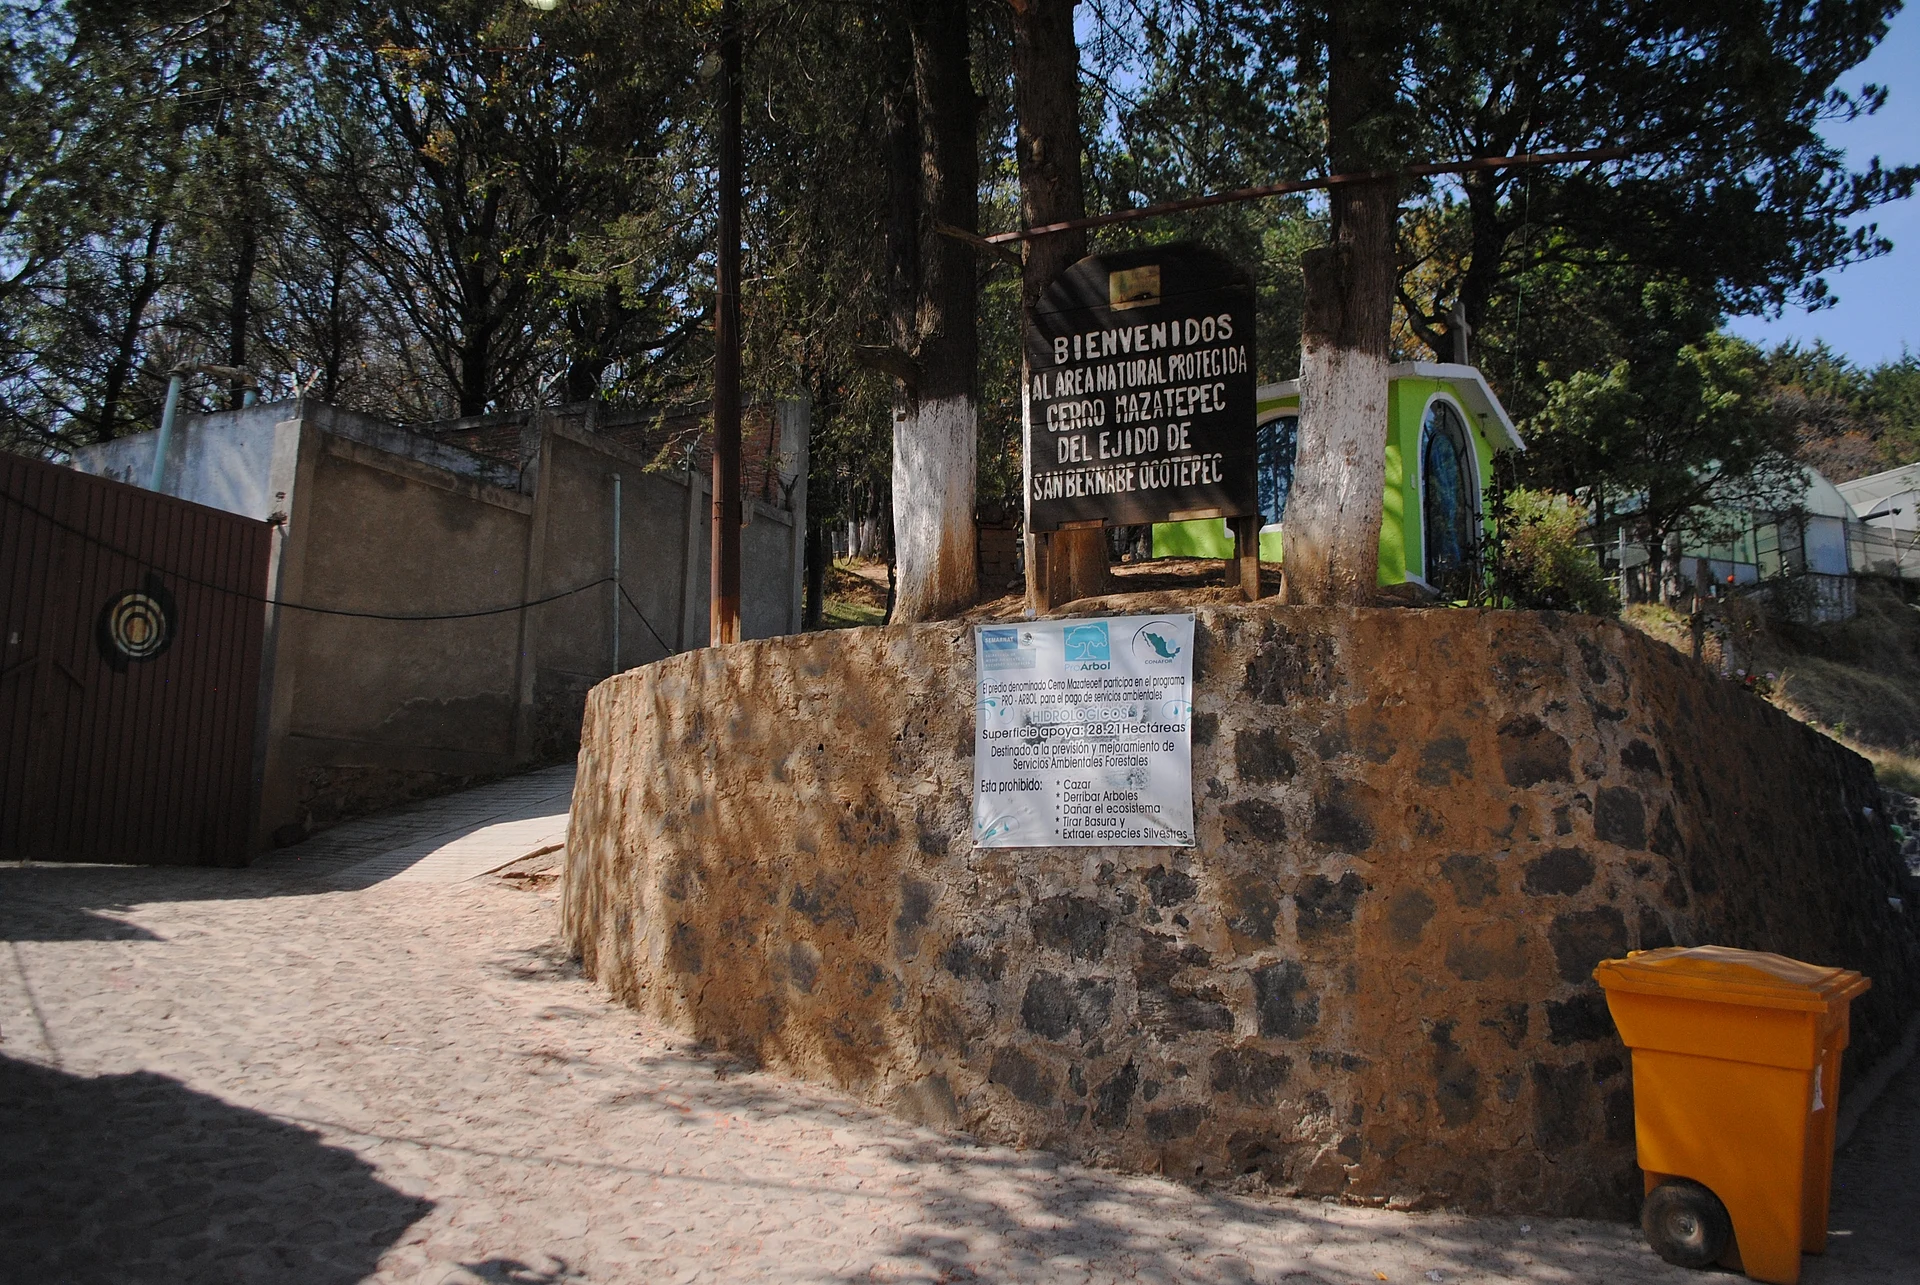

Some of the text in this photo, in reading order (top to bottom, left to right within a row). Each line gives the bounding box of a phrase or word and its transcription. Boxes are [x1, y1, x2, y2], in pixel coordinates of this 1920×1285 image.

[1054, 313, 1233, 365] BIENVENIDOS
[1032, 345, 1248, 401] AL AREA NATURAL PROTEGIDA
[1046, 382, 1226, 432] CERRO MAZATEPEC
[1057, 421, 1192, 464] DEL EJIDO DE
[1033, 452, 1224, 501] SAN BERNABE OCOTEPEC
[982, 682, 988, 694] El
[988, 680, 1007, 695] predio
[1008, 679, 1047, 693] denominado
[1047, 678, 1066, 690] Cerro
[1103, 676, 1133, 690] participa
[1134, 677, 1144, 688] en
[1144, 675, 1152, 687] el
[1152, 674, 1185, 689] programa
[1001, 693, 1014, 706] PRO
[1018, 692, 1037, 705] ARBOL
[1040, 692, 1056, 706] para
[1057, 691, 1064, 704] el
[1064, 691, 1083, 706] pago
[1083, 691, 1093, 703] de
[1093, 689, 1121, 703] servicios
[1122, 688, 1163, 702] ambientales
[1032, 707, 1127, 723] HIDROLOGICOS
[982, 726, 1037, 741] Superficie
[1040, 724, 1085, 739] apoya:
[1122, 721, 1186, 734] Hectáreas
[991, 739, 1175, 758] Destinado a la previsión y mejoramiento de
[1013, 754, 1149, 770] Servicios Ambientales Forestales
[981, 779, 1043, 794] Esta prohibido:
[1063, 779, 1092, 790] Cazar
[1063, 789, 1139, 802] Derribar Arboles
[1063, 802, 1161, 815] Dañar el ecosistema
[1063, 816, 1126, 829] Tirar Basura y
[1062, 826, 1188, 841] Extraer especies Silvestres
